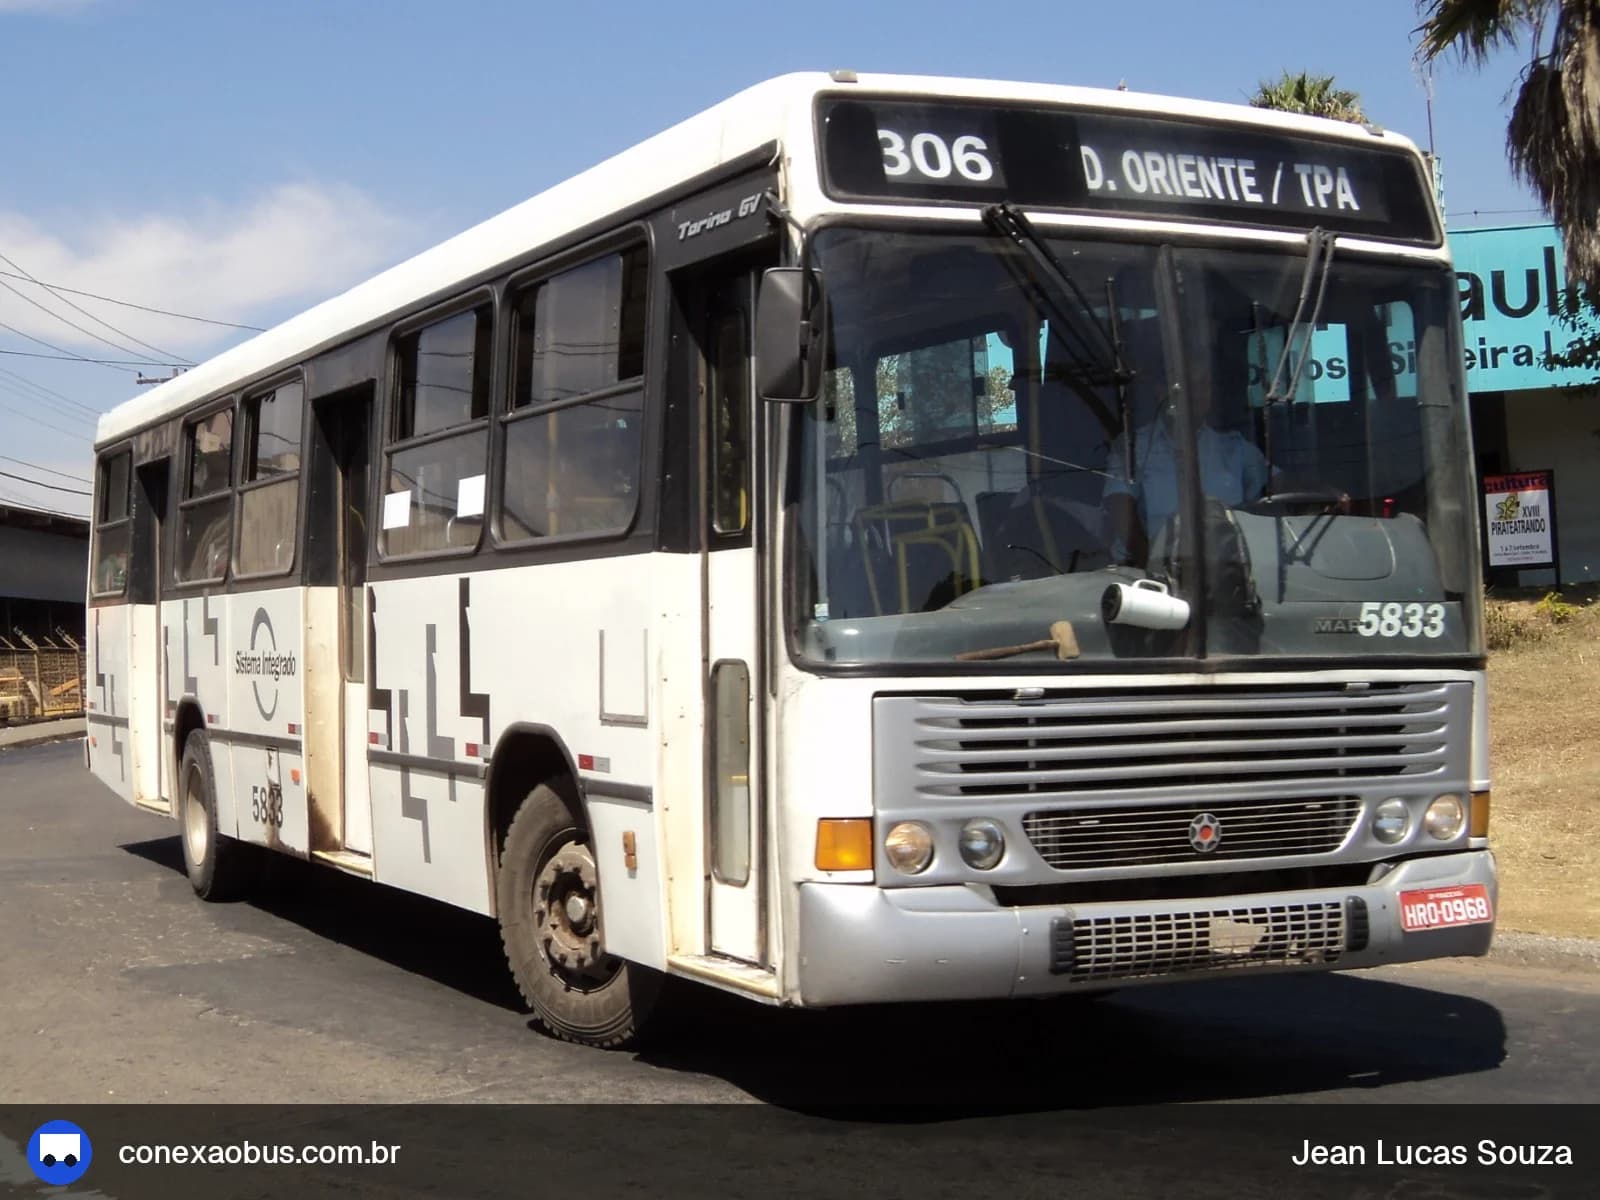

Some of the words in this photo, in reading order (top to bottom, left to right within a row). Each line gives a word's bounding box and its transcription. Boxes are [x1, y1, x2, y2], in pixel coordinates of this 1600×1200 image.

[876, 128, 993, 181] 306
[1121, 149, 1264, 204] ORIENTE
[1293, 163, 1361, 211] TPA
[677, 209, 732, 241] Torino
[738, 192, 762, 218] GV
[1491, 518, 1546, 536] PIRATEATRANDO
[1522, 504, 1540, 518] XVIII
[1357, 602, 1447, 639] 5833
[235, 650, 261, 675] Sistema
[261, 649, 296, 682] Integrado
